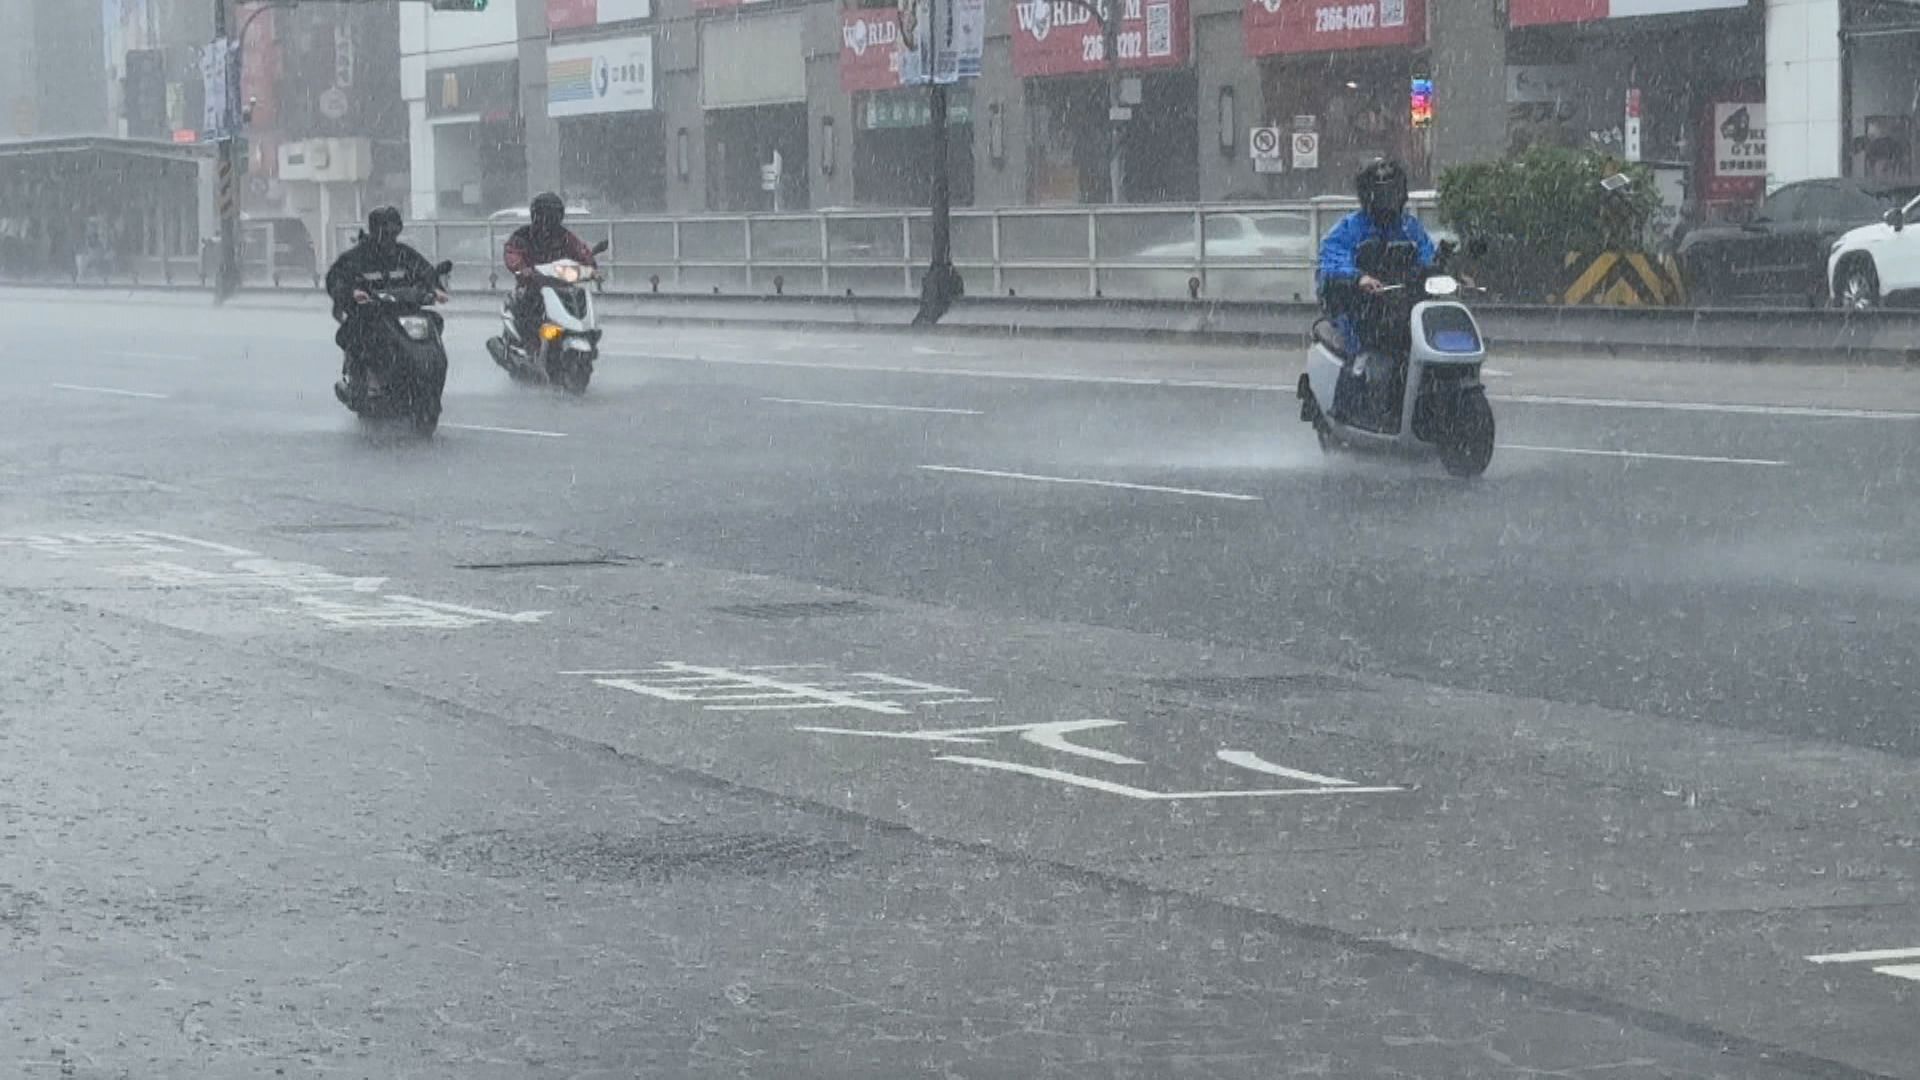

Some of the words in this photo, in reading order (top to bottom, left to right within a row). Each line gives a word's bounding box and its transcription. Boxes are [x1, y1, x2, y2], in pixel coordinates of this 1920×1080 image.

[1097, 0, 1142, 20] GM
[1315, 3, 1375, 32] 2366-0202
[1731, 143, 1767, 155] GYM
